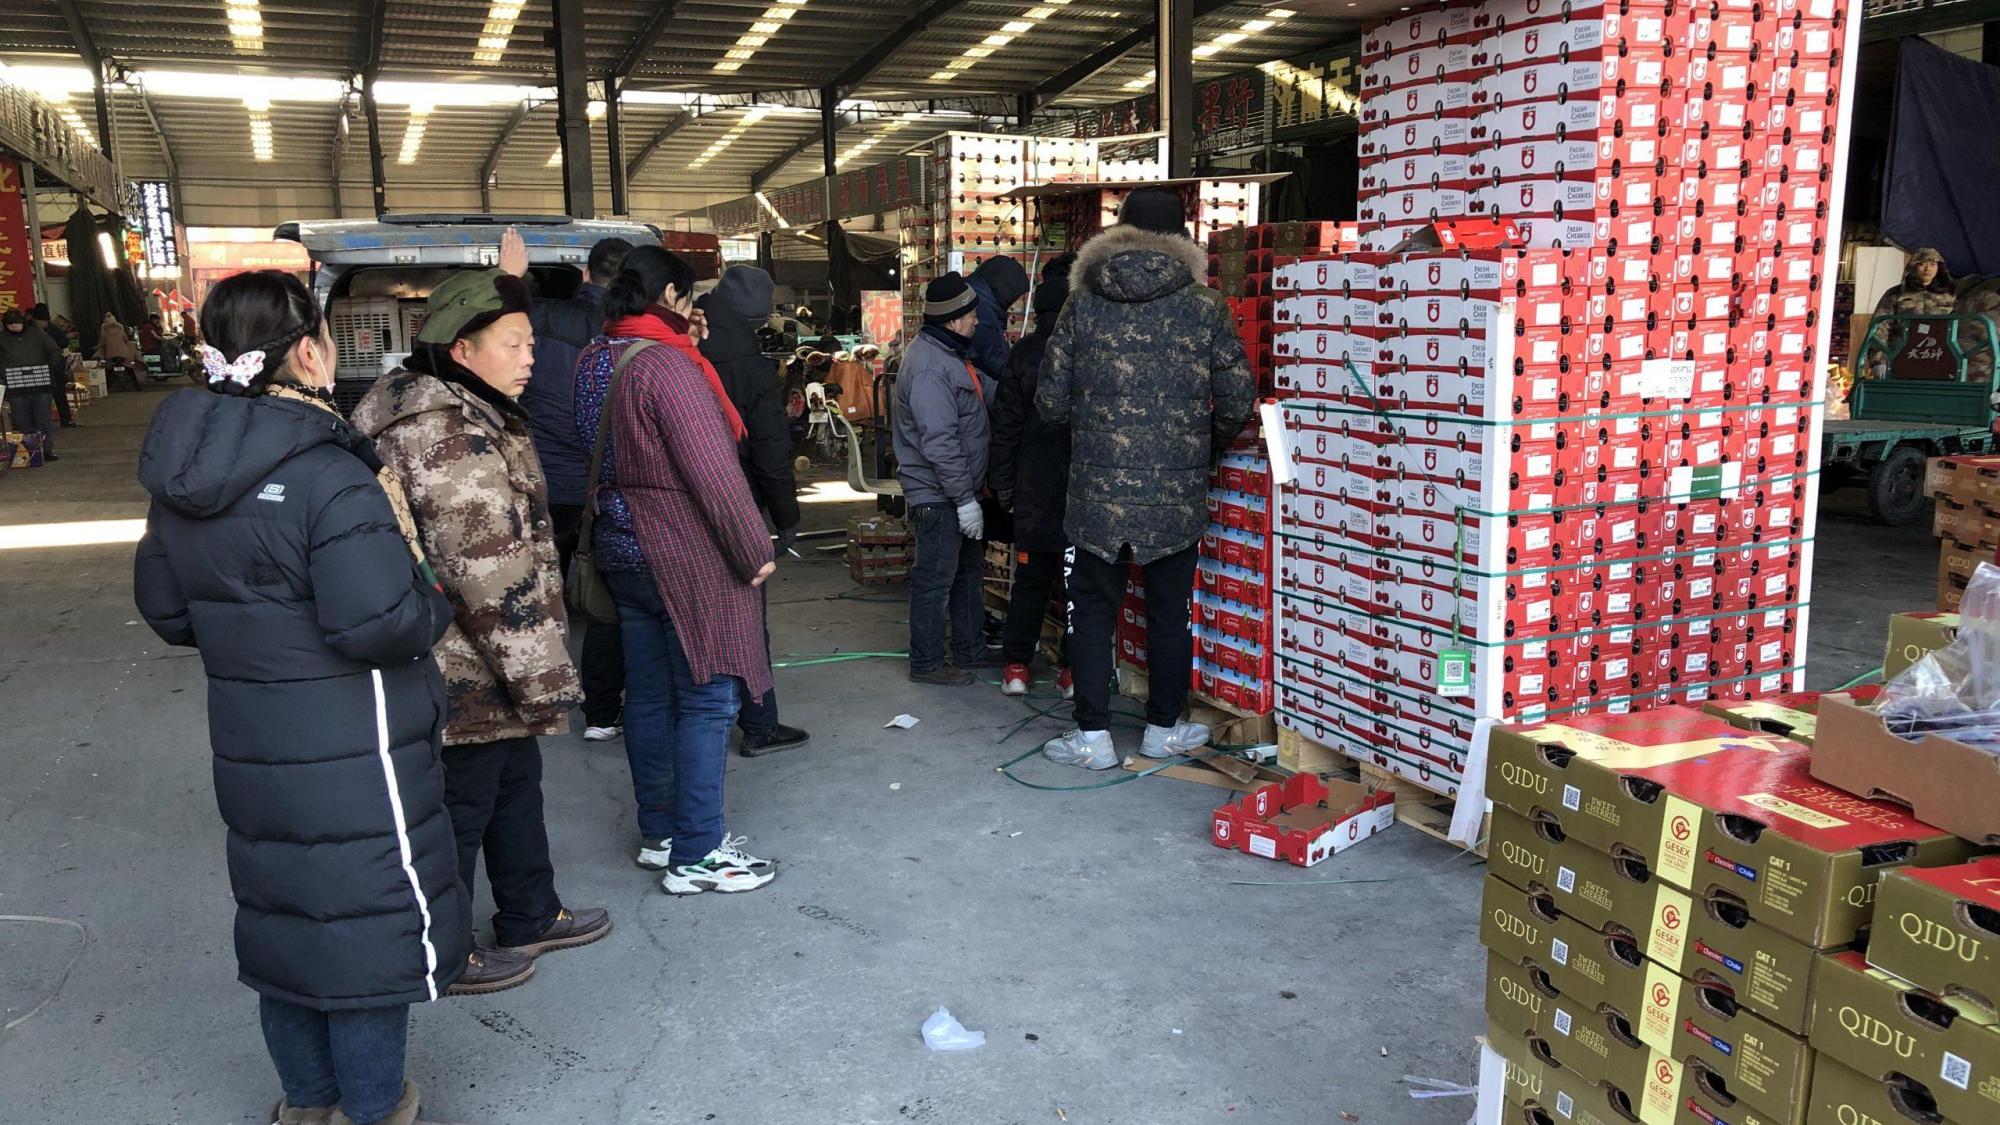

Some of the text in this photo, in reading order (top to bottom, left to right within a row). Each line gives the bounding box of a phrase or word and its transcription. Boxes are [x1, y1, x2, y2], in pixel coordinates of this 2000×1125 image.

[1273, 56, 1361, 127] 济南天
[1566, 225, 1583, 233] FRESH
[1474, 265, 1490, 273] FRESH
[1474, 271, 1498, 279] CHERRIES
[1947, 555, 1970, 568] QIDU
[1945, 592, 1961, 604] QID
[1502, 762, 1548, 795] QIDU
[1591, 797, 1617, 813] SWEET
[1803, 786, 1902, 818] SWEET
[1585, 802, 1621, 824] CHERRIES
[1502, 841, 1544, 875] QIDU
[1665, 841, 1690, 857] GESEX
[1769, 855, 1790, 871] CAT 1
[1579, 885, 1613, 909] CHERRIES
[1585, 880, 1609, 898] SWEET
[1848, 883, 1878, 907] QI
[1494, 908, 1538, 945] QIDU
[1655, 928, 1680, 947] GESEX
[1900, 912, 1981, 962] QIDU
[1578, 953, 1601, 971] SWEET
[1756, 950, 1776, 967] CAT 1
[1572, 958, 1605, 983] CHERRIES
[1499, 976, 1542, 1014] QIDU
[1646, 1005, 1670, 1025] GESEX
[1581, 1025, 1605, 1044] SWEET
[1744, 1033, 1764, 1050] CAT 1
[1839, 1006, 1917, 1058] QIDU
[1575, 1030, 1609, 1056] CHERRIES
[1650, 1082, 1673, 1101] GESEX
